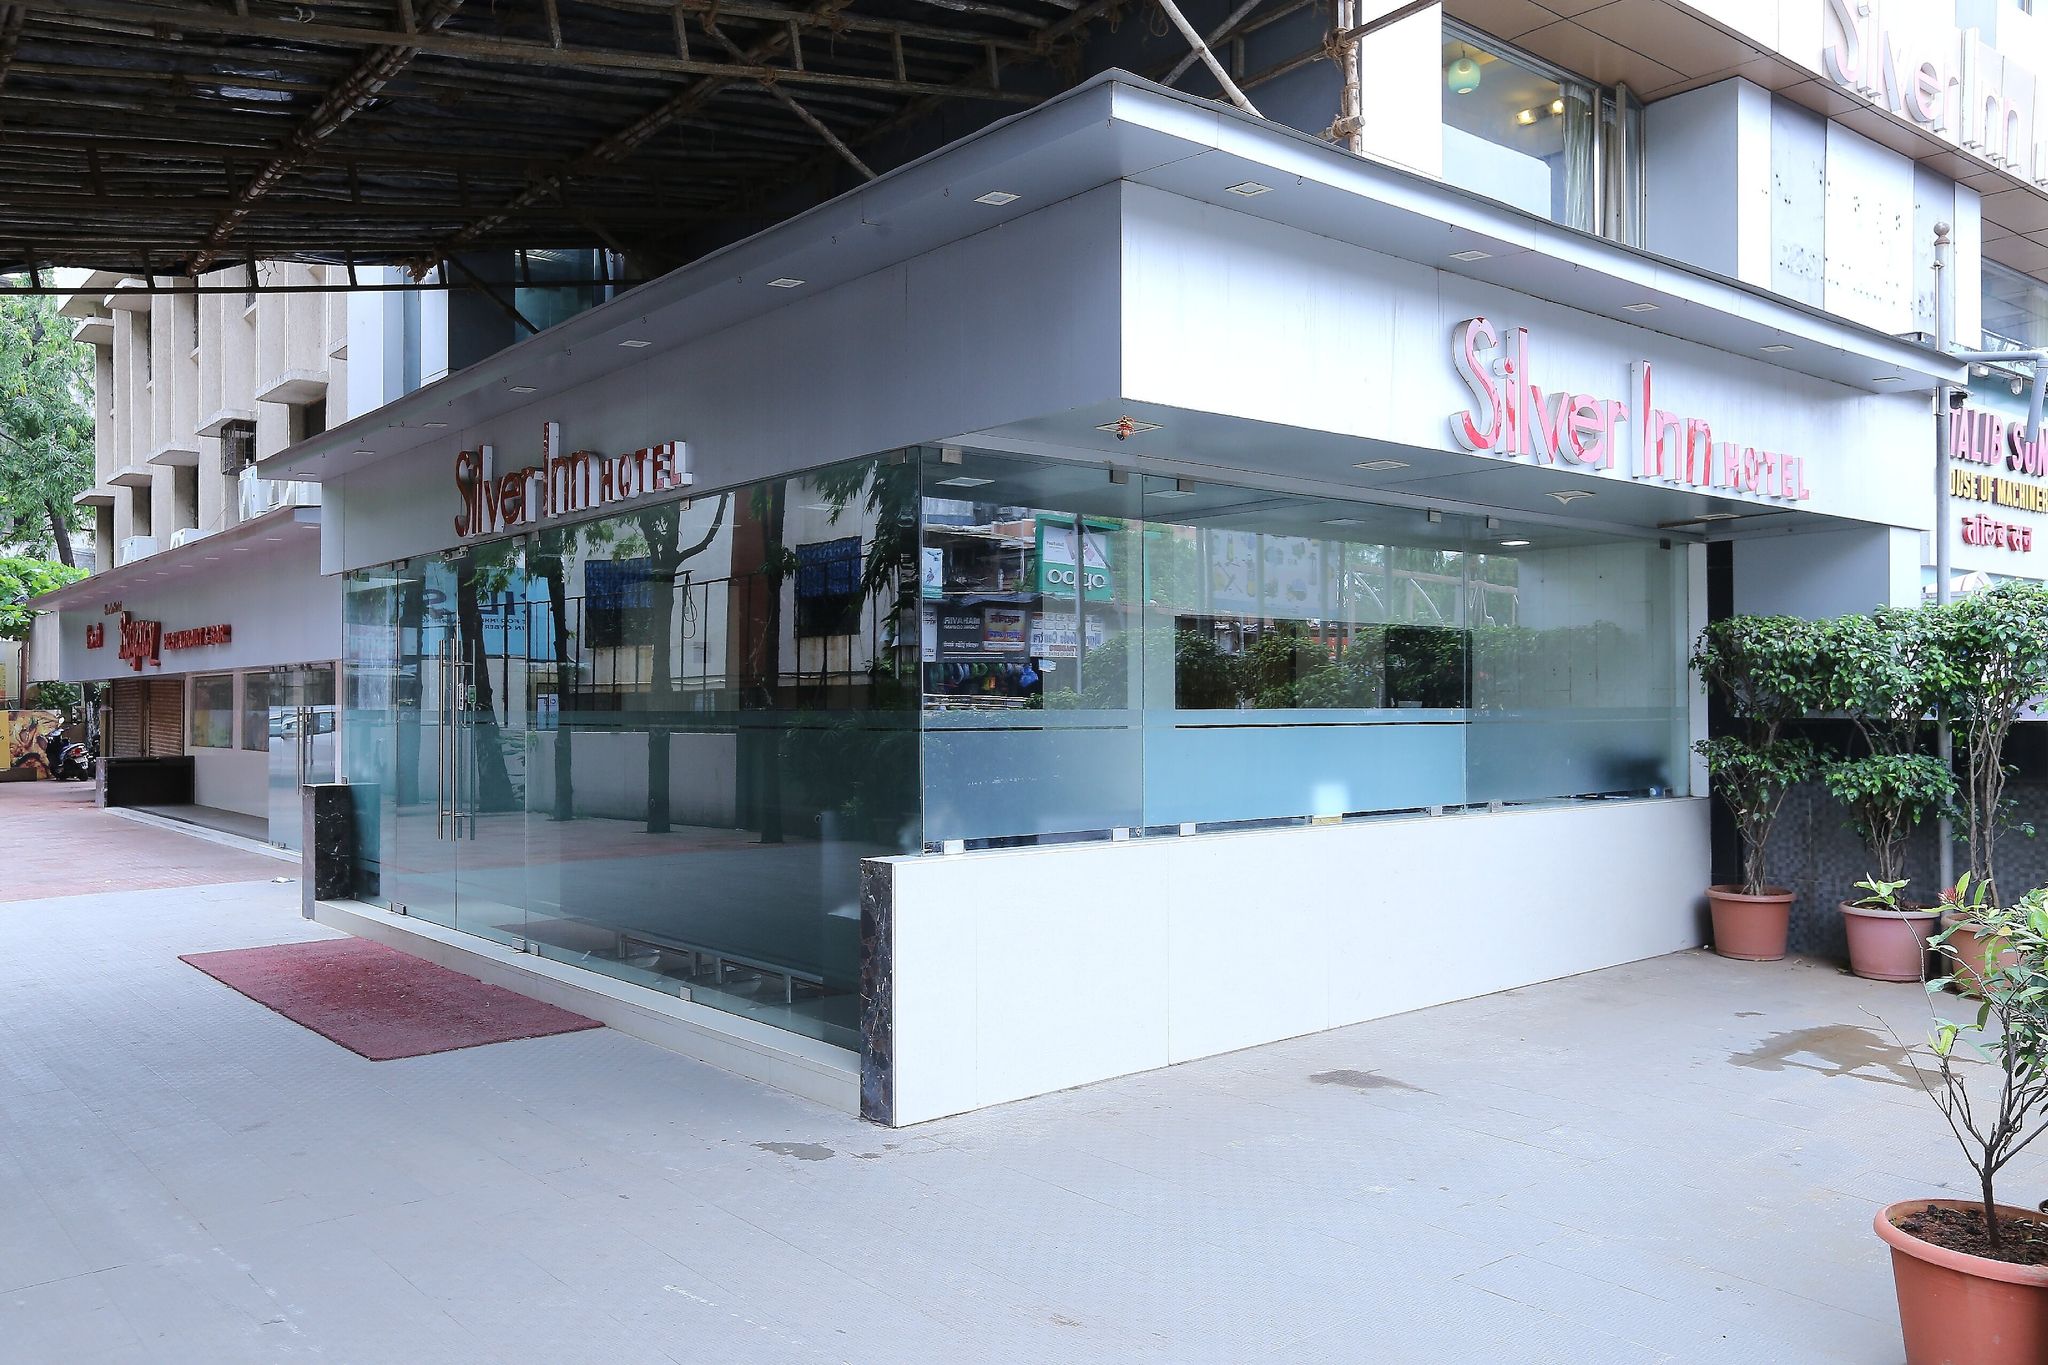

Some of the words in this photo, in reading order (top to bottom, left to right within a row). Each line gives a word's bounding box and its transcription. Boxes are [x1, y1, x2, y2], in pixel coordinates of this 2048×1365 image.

[1958, 27, 2034, 169] Inn
[1449, 316, 1629, 470] Silver
[1630, 360, 1713, 487] Inn
[1712, 441, 1811, 501] HOTEL
[455, 445, 545, 538] Silver
[543, 422, 601, 518] Inn
[601, 440, 693, 503] HOTEL
[1950, 468, 1978, 500] OUSE
[1980, 474, 1998, 504] OF
